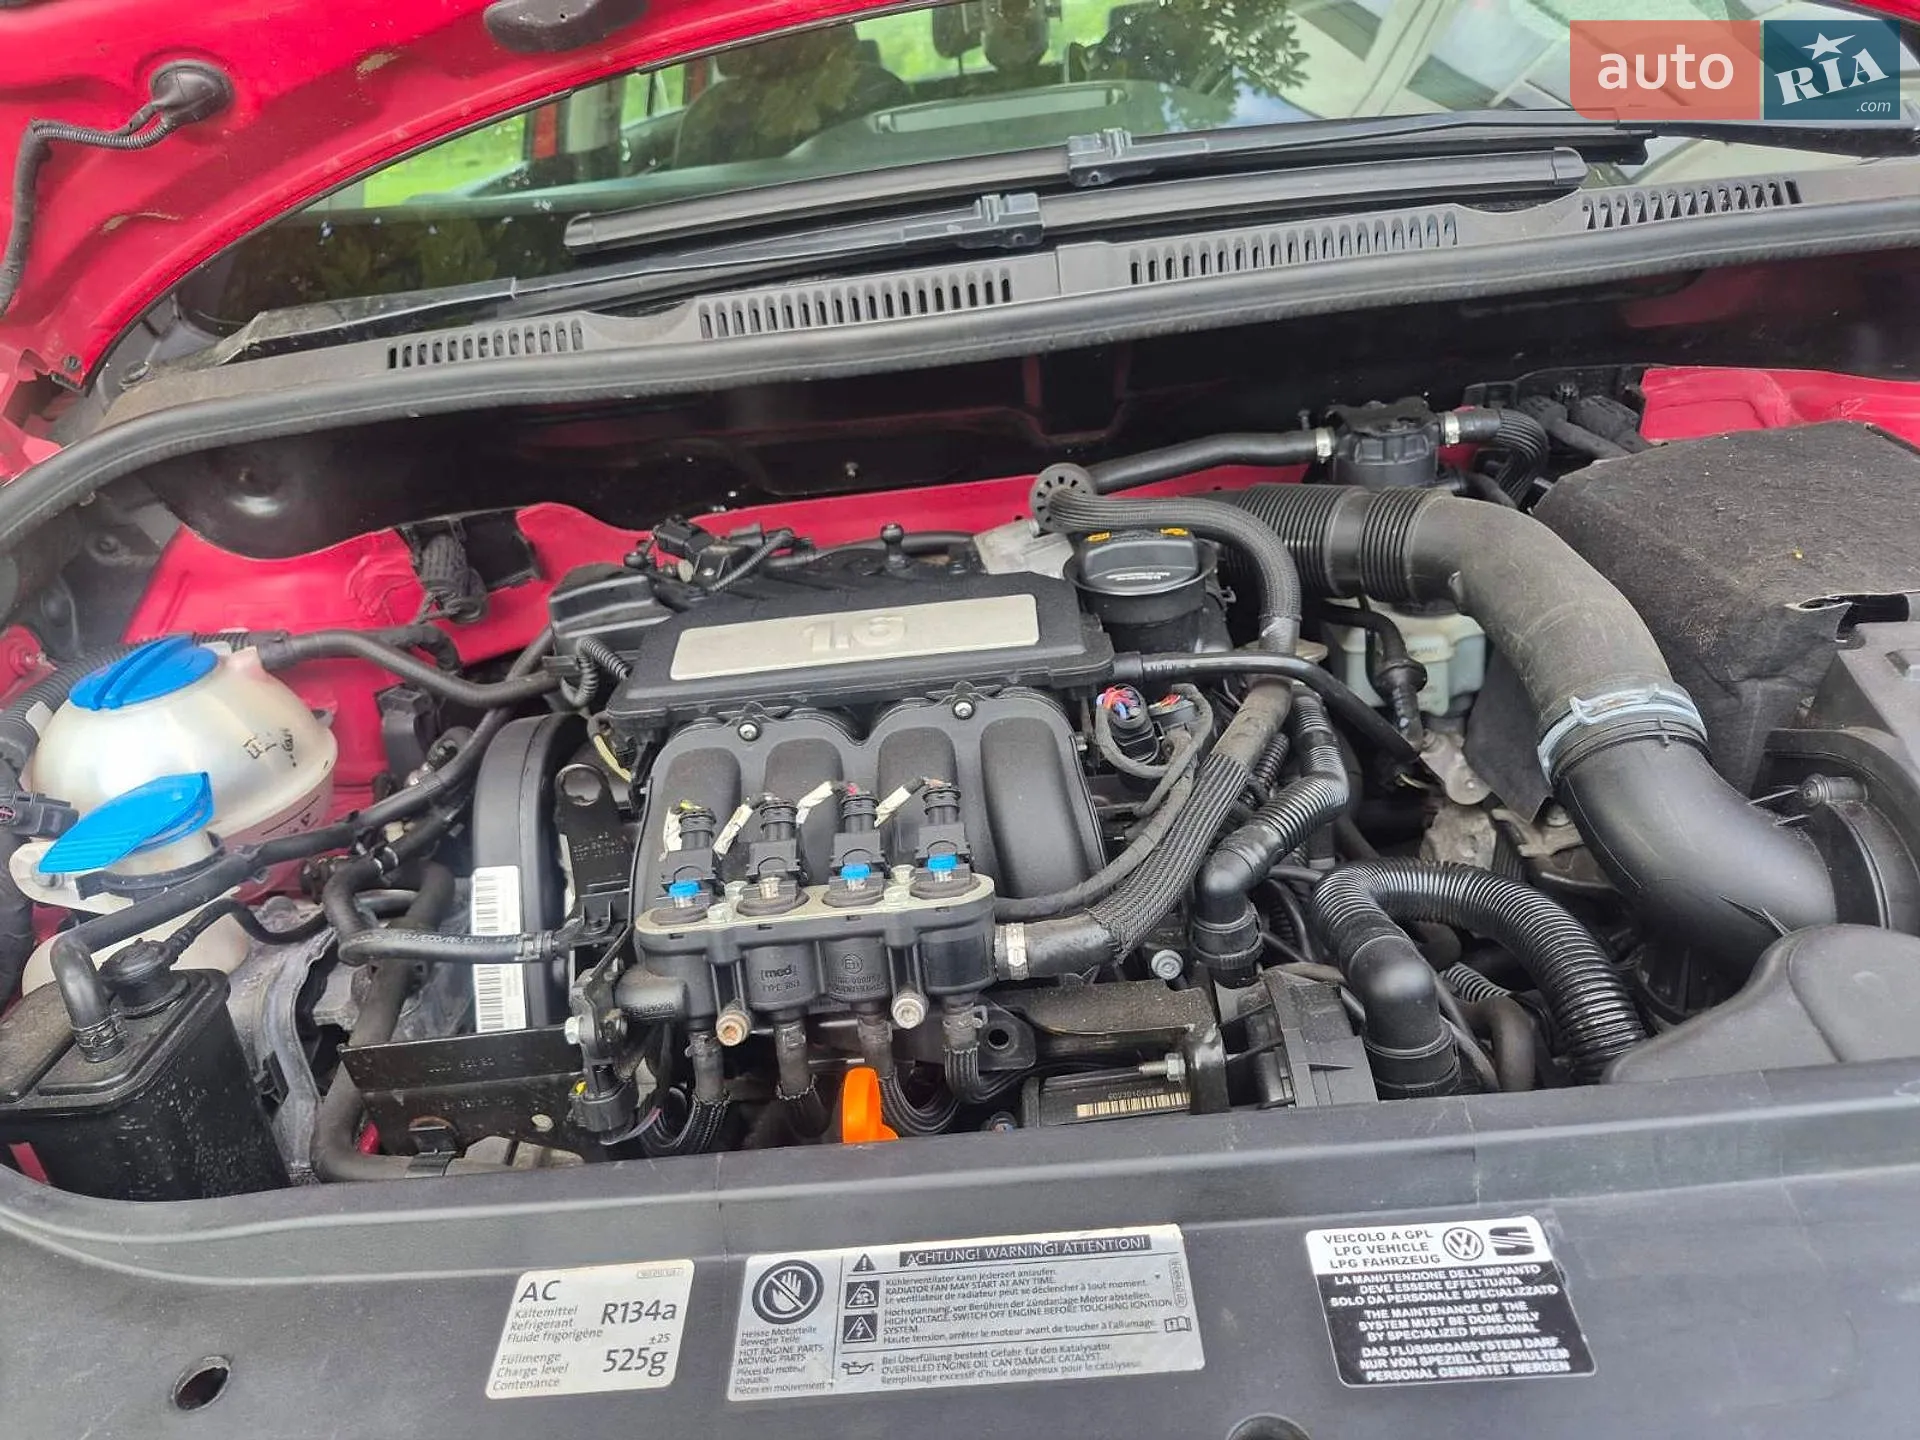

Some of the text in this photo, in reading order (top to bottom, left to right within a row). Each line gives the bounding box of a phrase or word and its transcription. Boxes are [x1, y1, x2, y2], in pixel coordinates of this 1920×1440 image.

[1323, 1229, 1434, 1244] VEICOLO A GPL
[905, 1236, 1146, 1264] ACHTUNG! WARNING! ATTENTION!
[1333, 1242, 1429, 1256] LPG VEHICLE
[1329, 1254, 1441, 1269] LPG FAHRZEUG
[1334, 1264, 1541, 1286] LA MANUTENZIONE DELL'IMPIANTO
[518, 1280, 561, 1303] AC
[885, 1285, 929, 1295] RADIATOR
[930, 1283, 948, 1292] FAN
[950, 1282, 969, 1290] MAY
[972, 1280, 997, 1289] START
[999, 1279, 1009, 1287] AT
[1012, 1278, 1030, 1286] ANY
[1360, 1276, 1524, 1295] DEVE ESSERE EFFETTUATA
[896, 1293, 942, 1304] ventilateur
[957, 1290, 996, 1300] radiateur
[999, 1288, 1019, 1298] peut
[1080, 1293, 1107, 1303] Motor
[1330, 1284, 1559, 1307] SOLO DA PERSONALE SPECIALIZZATO
[601, 1299, 677, 1325] R134a
[885, 1316, 908, 1325] HIGH
[952, 1311, 988, 1321] SWITCH
[989, 1310, 1005, 1319] OFF
[1008, 1308, 1043, 1318] ENGINE
[1044, 1305, 1077, 1315] BEFORE
[1079, 1301, 1129, 1312] TOUCHING
[1130, 1299, 1173, 1309] IGNITION
[1363, 1300, 1529, 1320] THE MAINTENANCE OF THE
[511, 1318, 573, 1332] Refrigerant
[1358, 1311, 1540, 1332] SYSTEM MUST BE DONE ONLY
[508, 1328, 603, 1343] Fluide frigorigène
[649, 1333, 671, 1344] ±25
[742, 1329, 770, 1338] Heisse
[884, 1335, 911, 1344] Haute
[990, 1327, 1024, 1337] moteur
[1025, 1325, 1052, 1335] avant
[1065, 1322, 1100, 1332] toucher
[1366, 1323, 1541, 1342] BY SPECIALIZED PERSONAL
[740, 1343, 825, 1356] HOT ENGINE PARTS
[1361, 1346, 1389, 1358] DAS
[1523, 1336, 1560, 1348] DARF
[501, 1353, 561, 1366] Füllmenge
[603, 1347, 668, 1377] 525g
[738, 1354, 807, 1365] MOVING PARTS
[881, 1363, 935, 1375] OVERFILLED
[936, 1360, 971, 1371] ENGINE
[973, 1359, 988, 1369] OIL
[992, 1358, 1012, 1367] CAN
[1012, 1354, 1056, 1366] DAMAGE
[1359, 1358, 1389, 1370] NUR
[1389, 1356, 1418, 1368] VON
[1418, 1353, 1480, 1367] SPEZIELL
[497, 1362, 569, 1378] Charge level
[881, 1373, 938, 1385] Remplissage
[1009, 1365, 1058, 1377] dangereux
[1060, 1363, 1082, 1374] pour
[1366, 1360, 1571, 1382] PERSONAL GEWARTET WERDEN
[493, 1379, 560, 1391] Contenance
